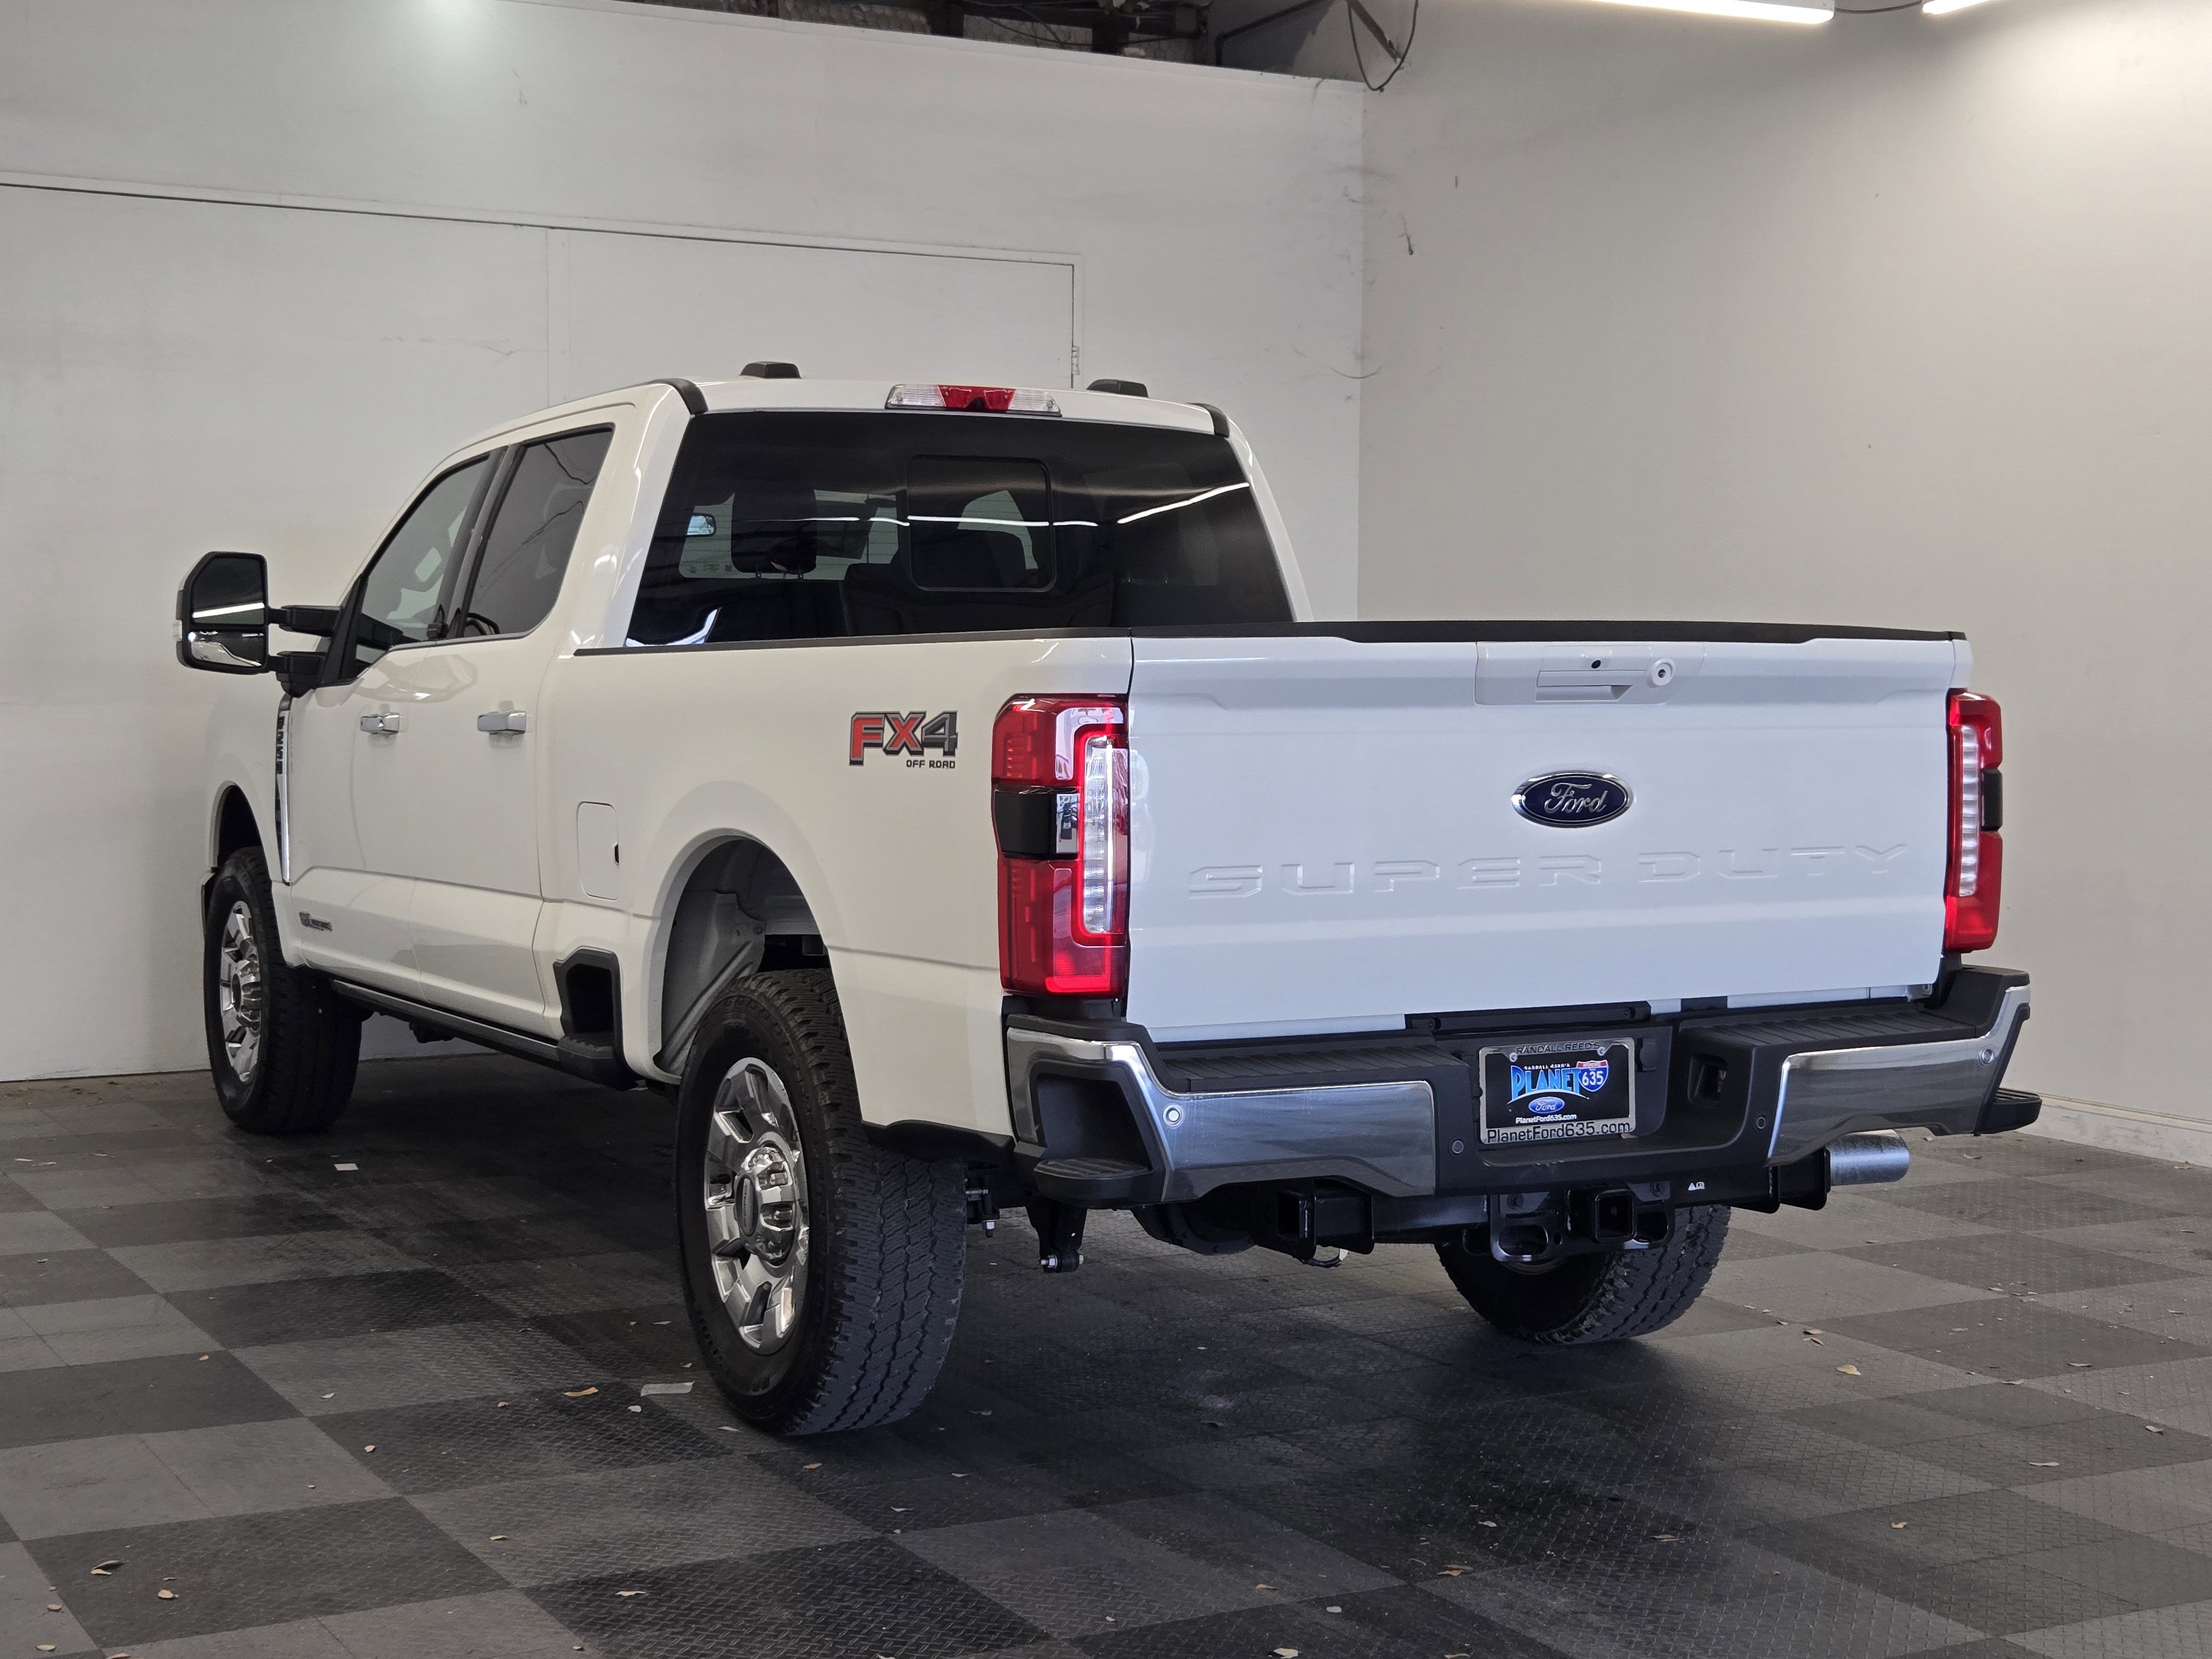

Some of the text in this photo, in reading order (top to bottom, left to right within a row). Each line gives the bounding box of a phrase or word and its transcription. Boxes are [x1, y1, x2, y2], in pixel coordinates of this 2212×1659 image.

[849, 711, 958, 766] FX4
[906, 759, 956, 769] OFF ROAD
[1544, 782, 1608, 814] Ford
[1188, 843, 1908, 899] SUPER DUTY
[1516, 1044, 1562, 1055] RANDALL
[1511, 1065, 1581, 1100] PLANET
[1582, 1071, 1604, 1087] 635
[1535, 1100, 1557, 1111] Ford
[1515, 1114, 1577, 1124] PlanetFord635.com
[1487, 1121, 1631, 1143] PlanetFord635.com
